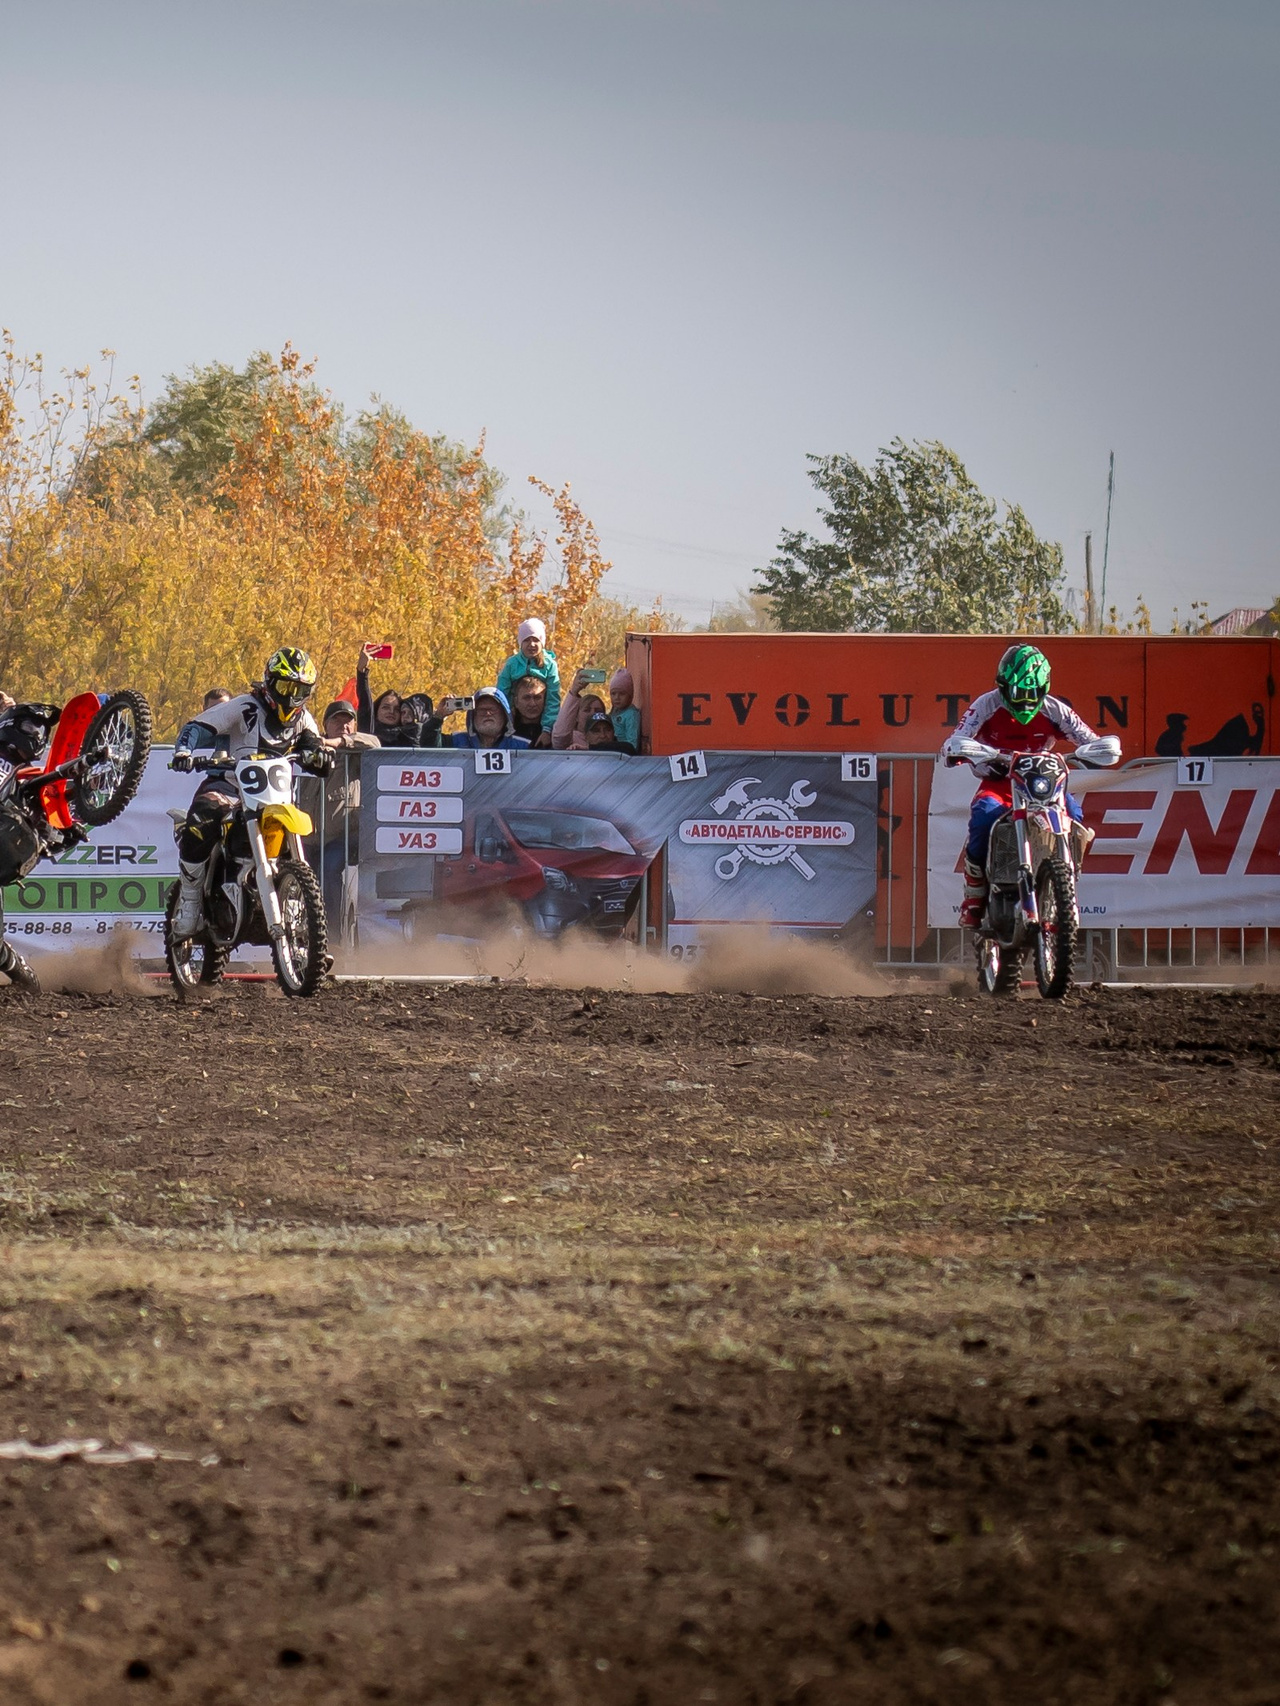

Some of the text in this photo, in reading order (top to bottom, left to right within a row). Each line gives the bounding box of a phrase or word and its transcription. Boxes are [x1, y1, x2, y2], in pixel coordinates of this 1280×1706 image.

[677, 692, 1130, 729] EVOLUTN
[482, 752, 504, 771] 13
[677, 756, 700, 776] 14
[847, 758, 871, 778] 15
[1020, 756, 1058, 771] 373
[239, 765, 292, 796] 96
[399, 771, 441, 788] ВАЗ
[1186, 761, 1205, 782] 17
[398, 801, 437, 818] ГАЗ
[397, 832, 437, 849] УАЗ
[685, 824, 847, 840] «АВТОДЕТАЛЬ-СЕРВИС»
